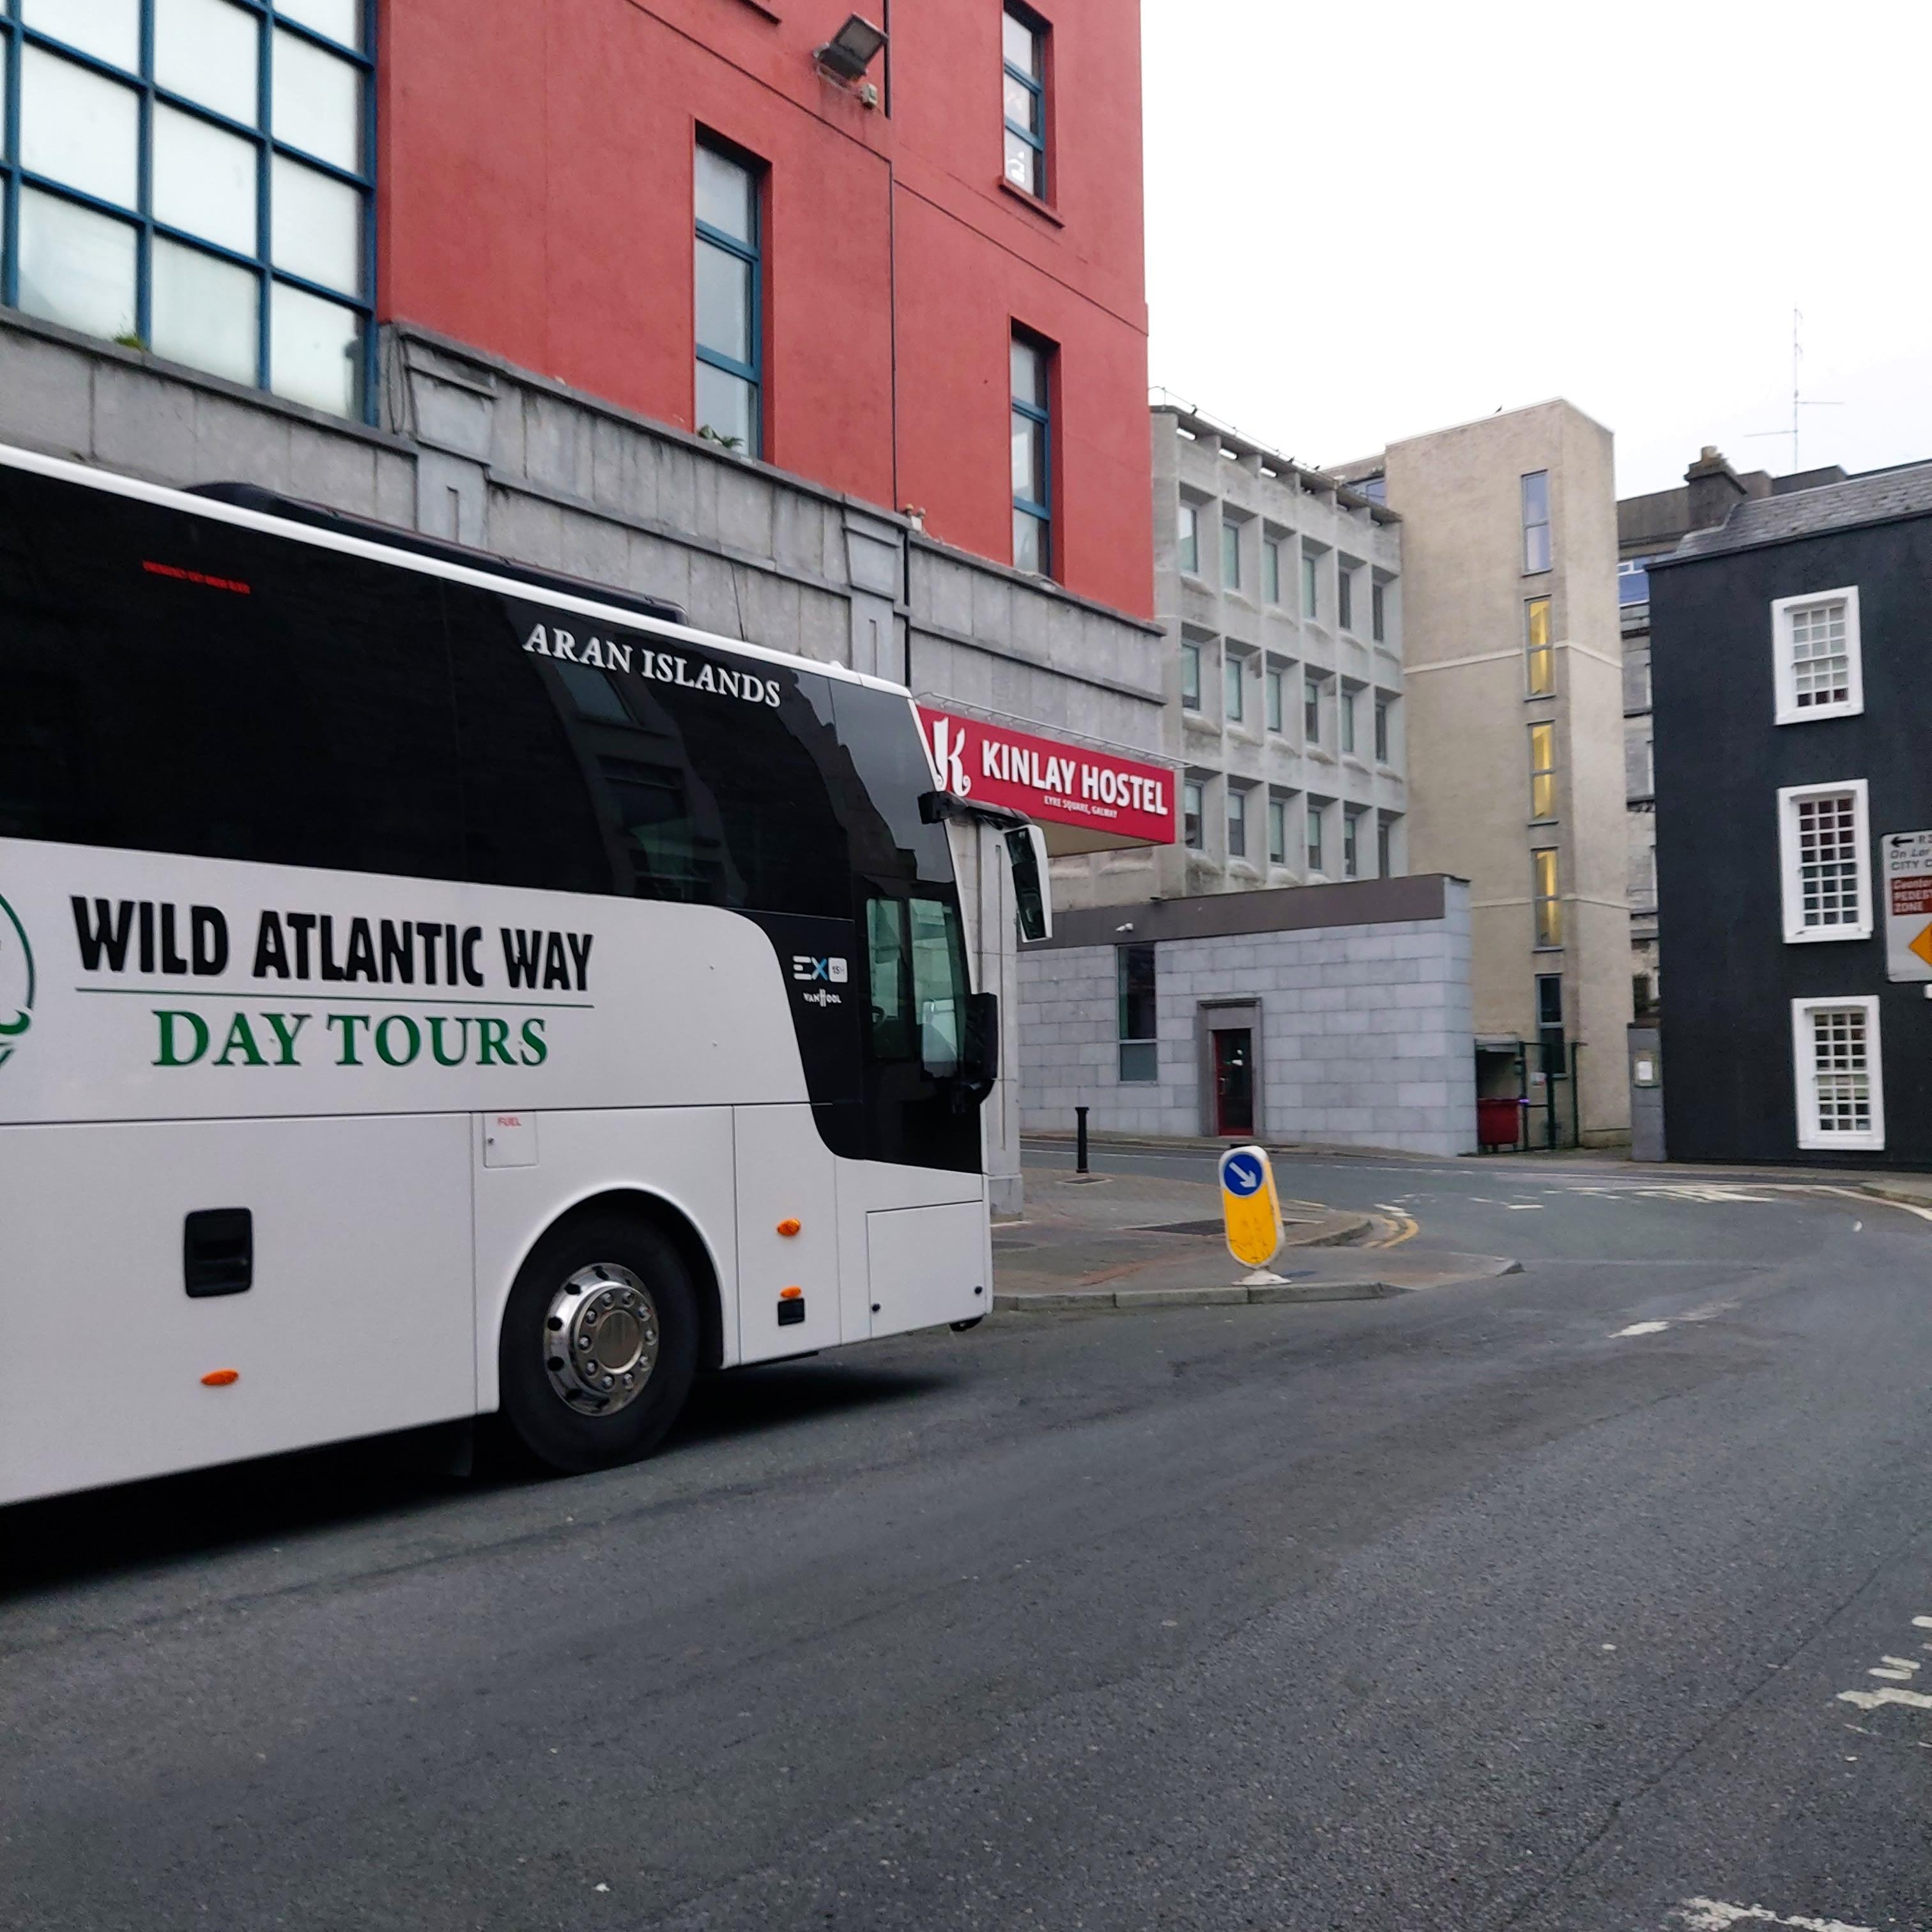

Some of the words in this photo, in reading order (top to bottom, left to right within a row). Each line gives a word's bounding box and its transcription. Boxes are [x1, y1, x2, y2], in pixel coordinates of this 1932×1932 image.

[523, 623, 633, 674] ARAN
[641, 648, 781, 708] ISLANDS
[981, 739, 1077, 795] KINLAY
[1081, 763, 1169, 816] HOSTEL
[1043, 795, 1062, 808] EYRE
[1091, 806, 1118, 818] GALWAY
[1891, 860, 1919, 870] CITY
[70, 895, 229, 976] WILD
[253, 910, 484, 987] ATLANTIC
[501, 927, 594, 991] WAY
[151, 1009, 312, 1068] DAY
[327, 1015, 549, 1068] TOURS
